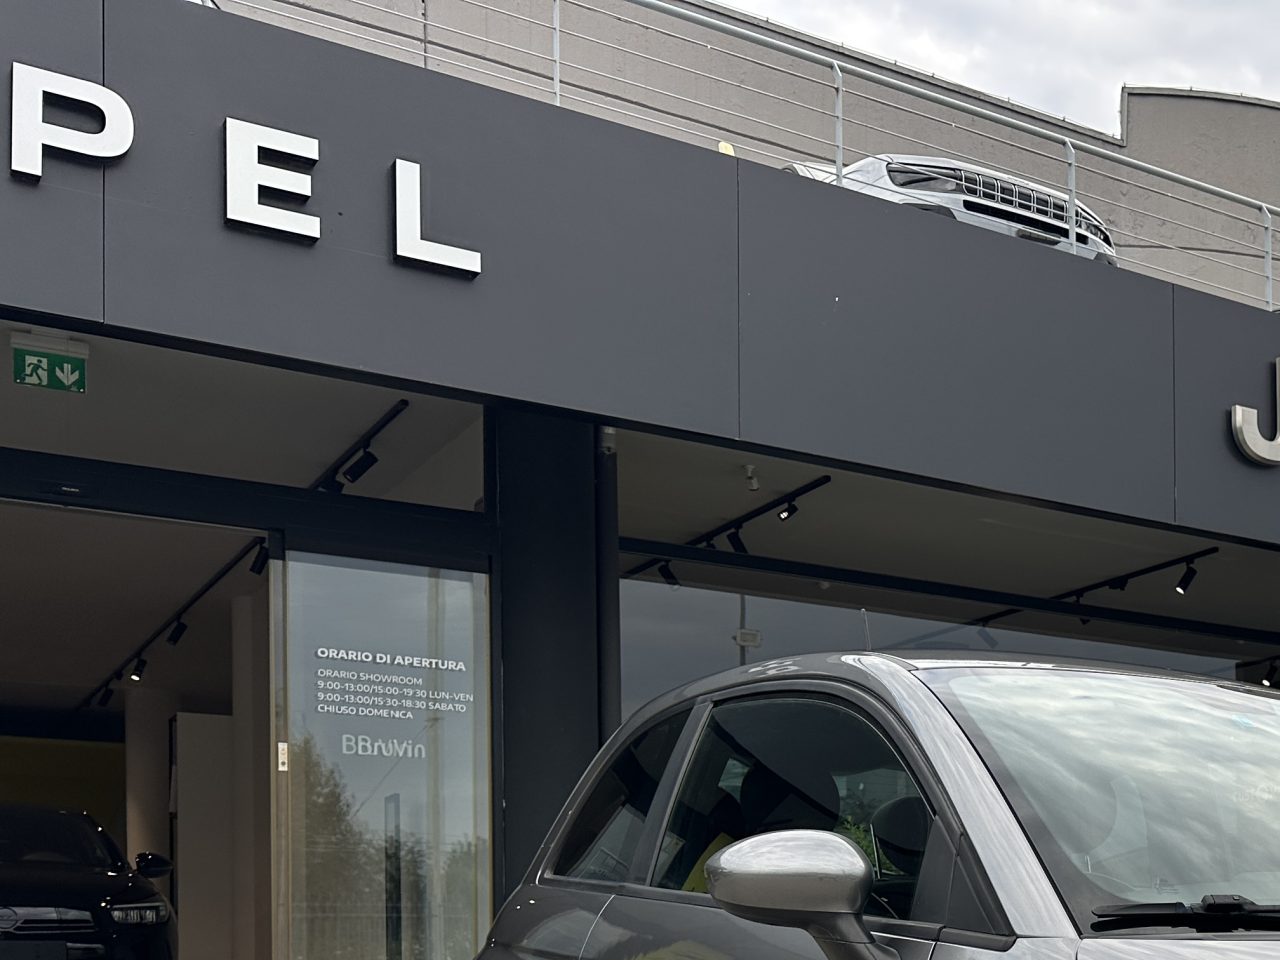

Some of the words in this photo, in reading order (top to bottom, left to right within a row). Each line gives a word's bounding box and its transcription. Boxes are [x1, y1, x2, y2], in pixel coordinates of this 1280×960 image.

[317, 647, 373, 662] ORARIO
[376, 653, 391, 664] DI
[394, 655, 466, 672] APERTURA
[317, 668, 358, 680] ORARIO
[359, 672, 423, 686] SHOWROOM
[429, 690, 474, 702] LUN-VEN
[317, 703, 357, 715] CHIUSO
[358, 707, 414, 719] DOMENICA
[428, 701, 467, 713] SABATO
